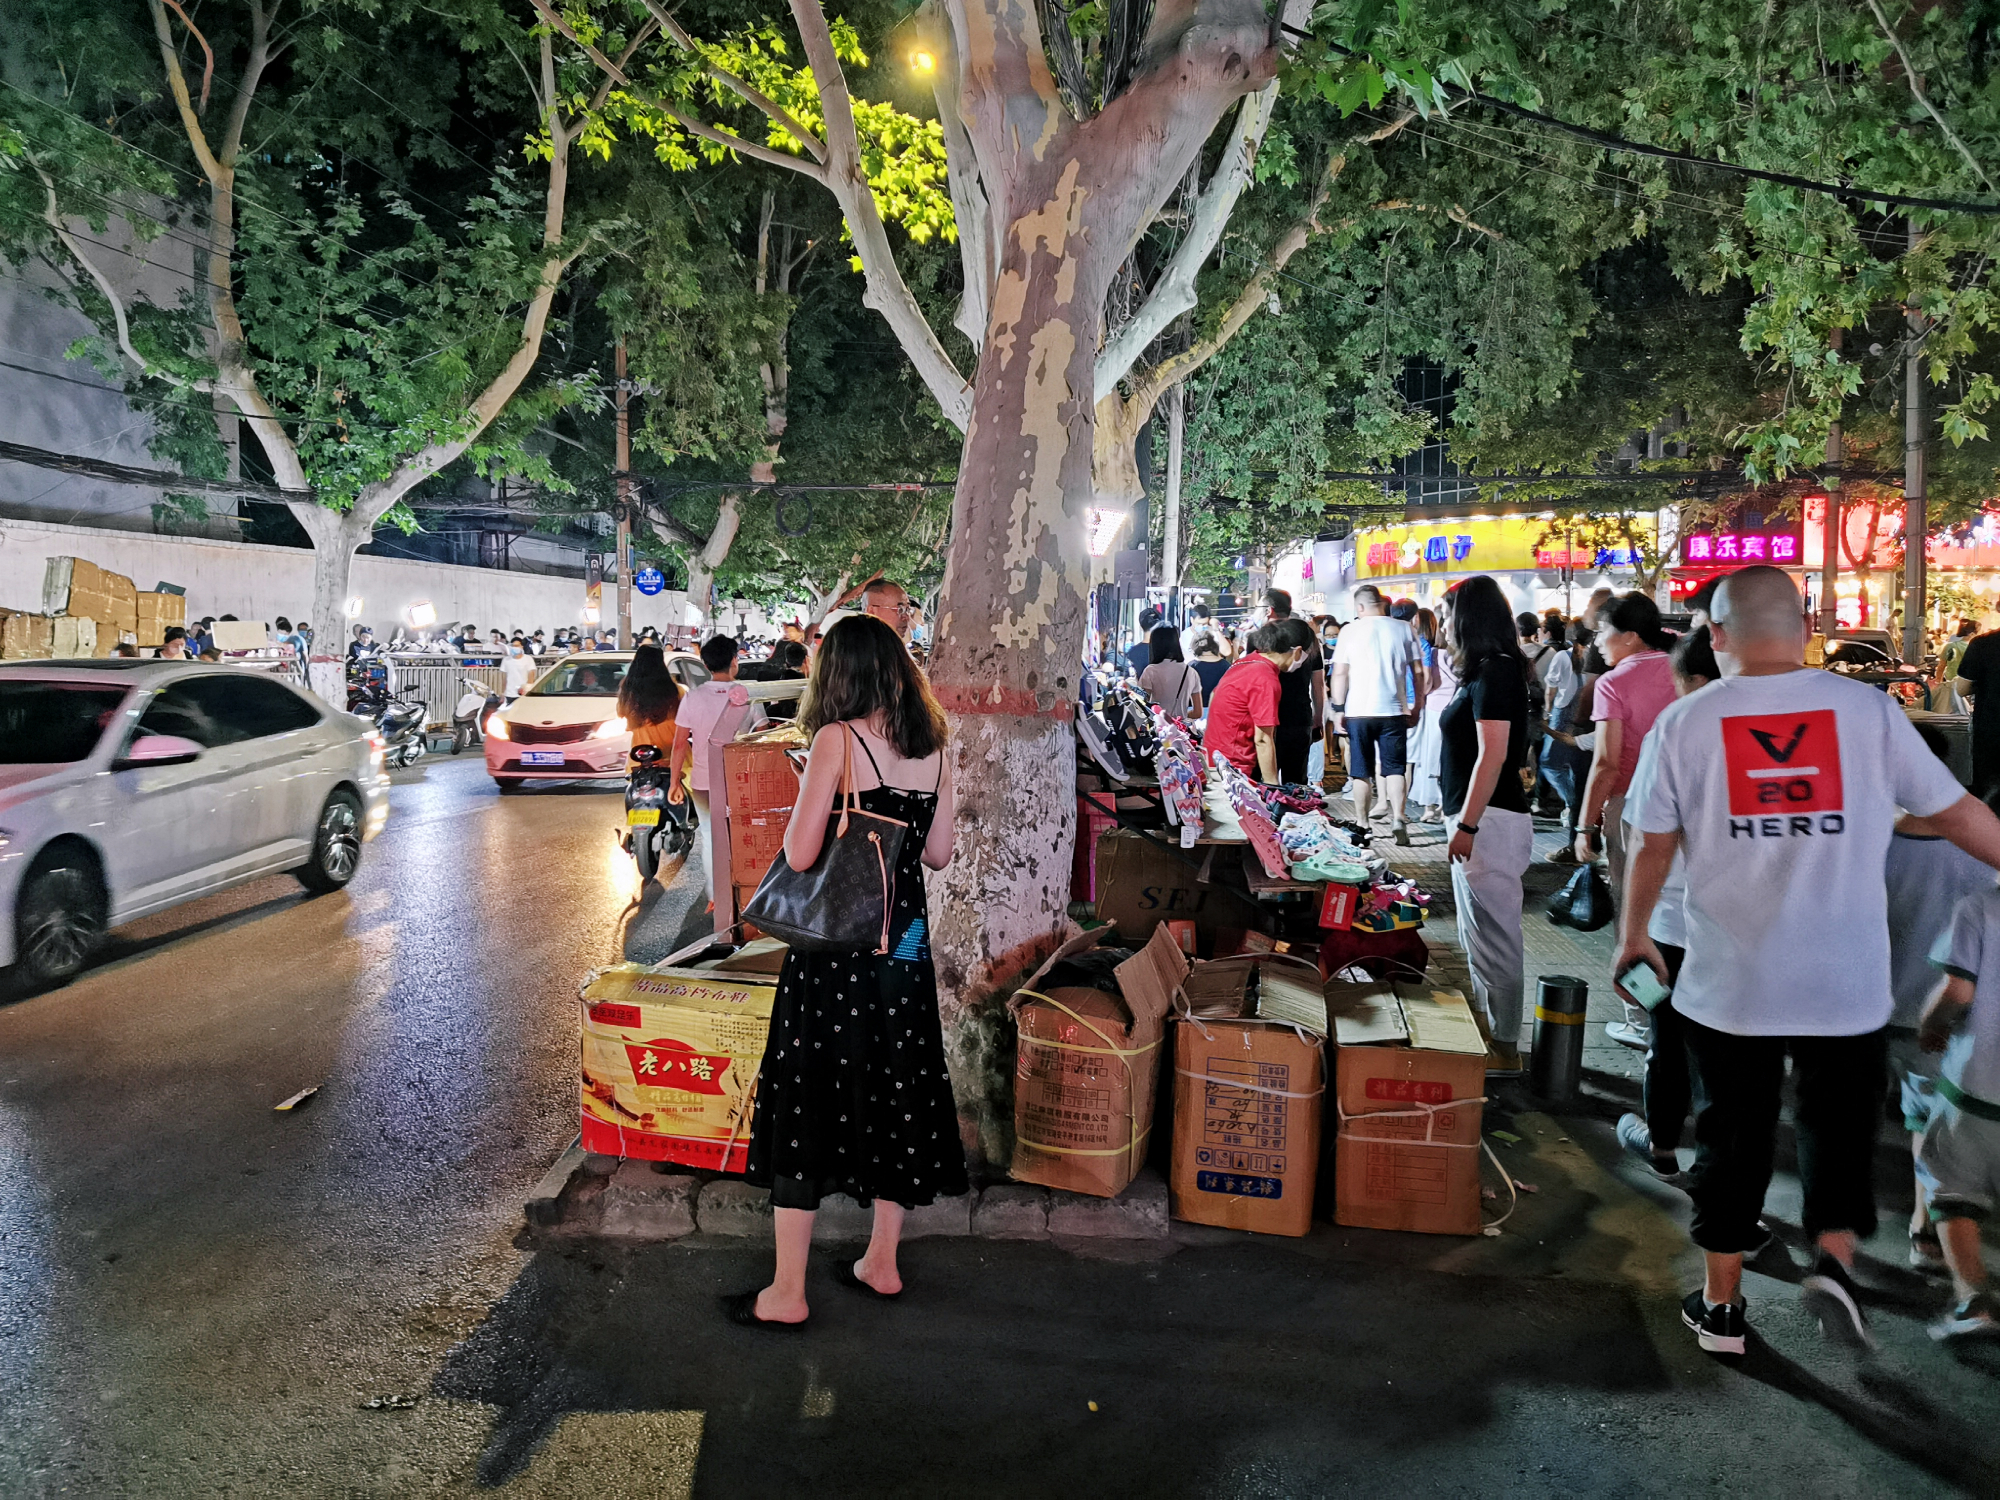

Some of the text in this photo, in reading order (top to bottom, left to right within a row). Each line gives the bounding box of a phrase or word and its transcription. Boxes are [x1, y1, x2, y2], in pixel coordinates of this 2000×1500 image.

[1688, 535, 1795, 559] 康乐宾馆
[1106, 719, 1118, 736] NIKE
[1124, 742, 1137, 759] NIKE
[1757, 780, 1813, 804] 20
[1729, 814, 1845, 839] HERO
[638, 1049, 715, 1081] 老八路
[1373, 1081, 1443, 1100] 精品系列
